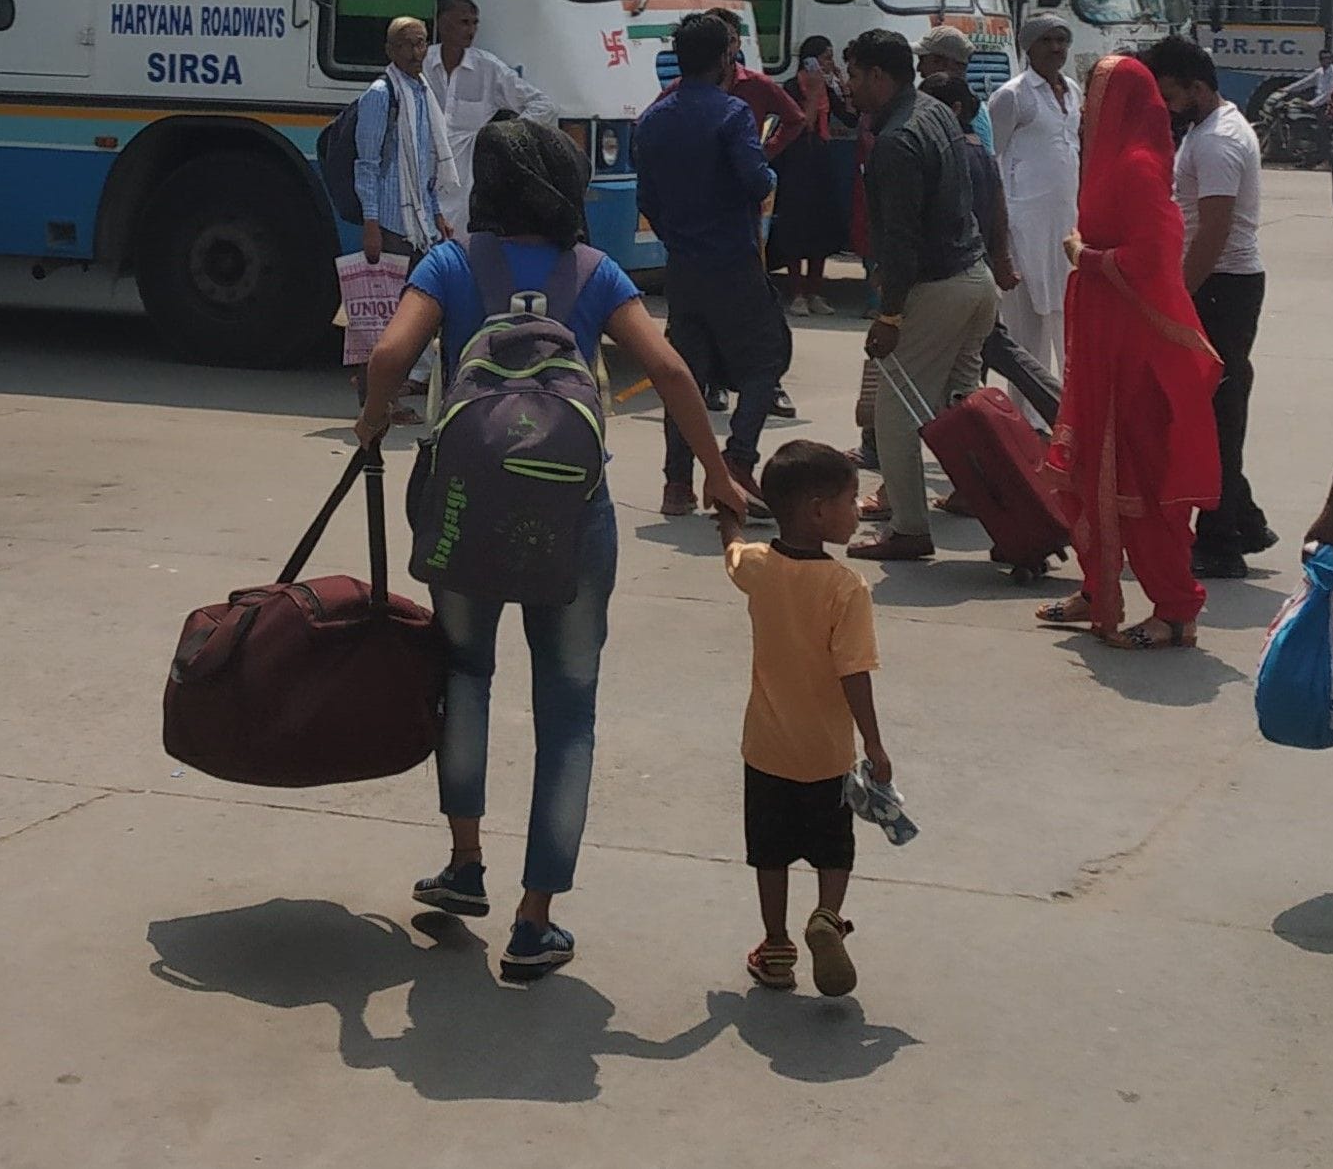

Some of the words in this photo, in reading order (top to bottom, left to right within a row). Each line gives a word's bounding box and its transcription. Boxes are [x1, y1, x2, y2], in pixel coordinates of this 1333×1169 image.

[110, 3, 194, 38] HARYANA
[200, 5, 286, 39] ROADWAYS
[1212, 37, 1304, 56] P.R.T.C.
[146, 51, 242, 85] SIRSA
